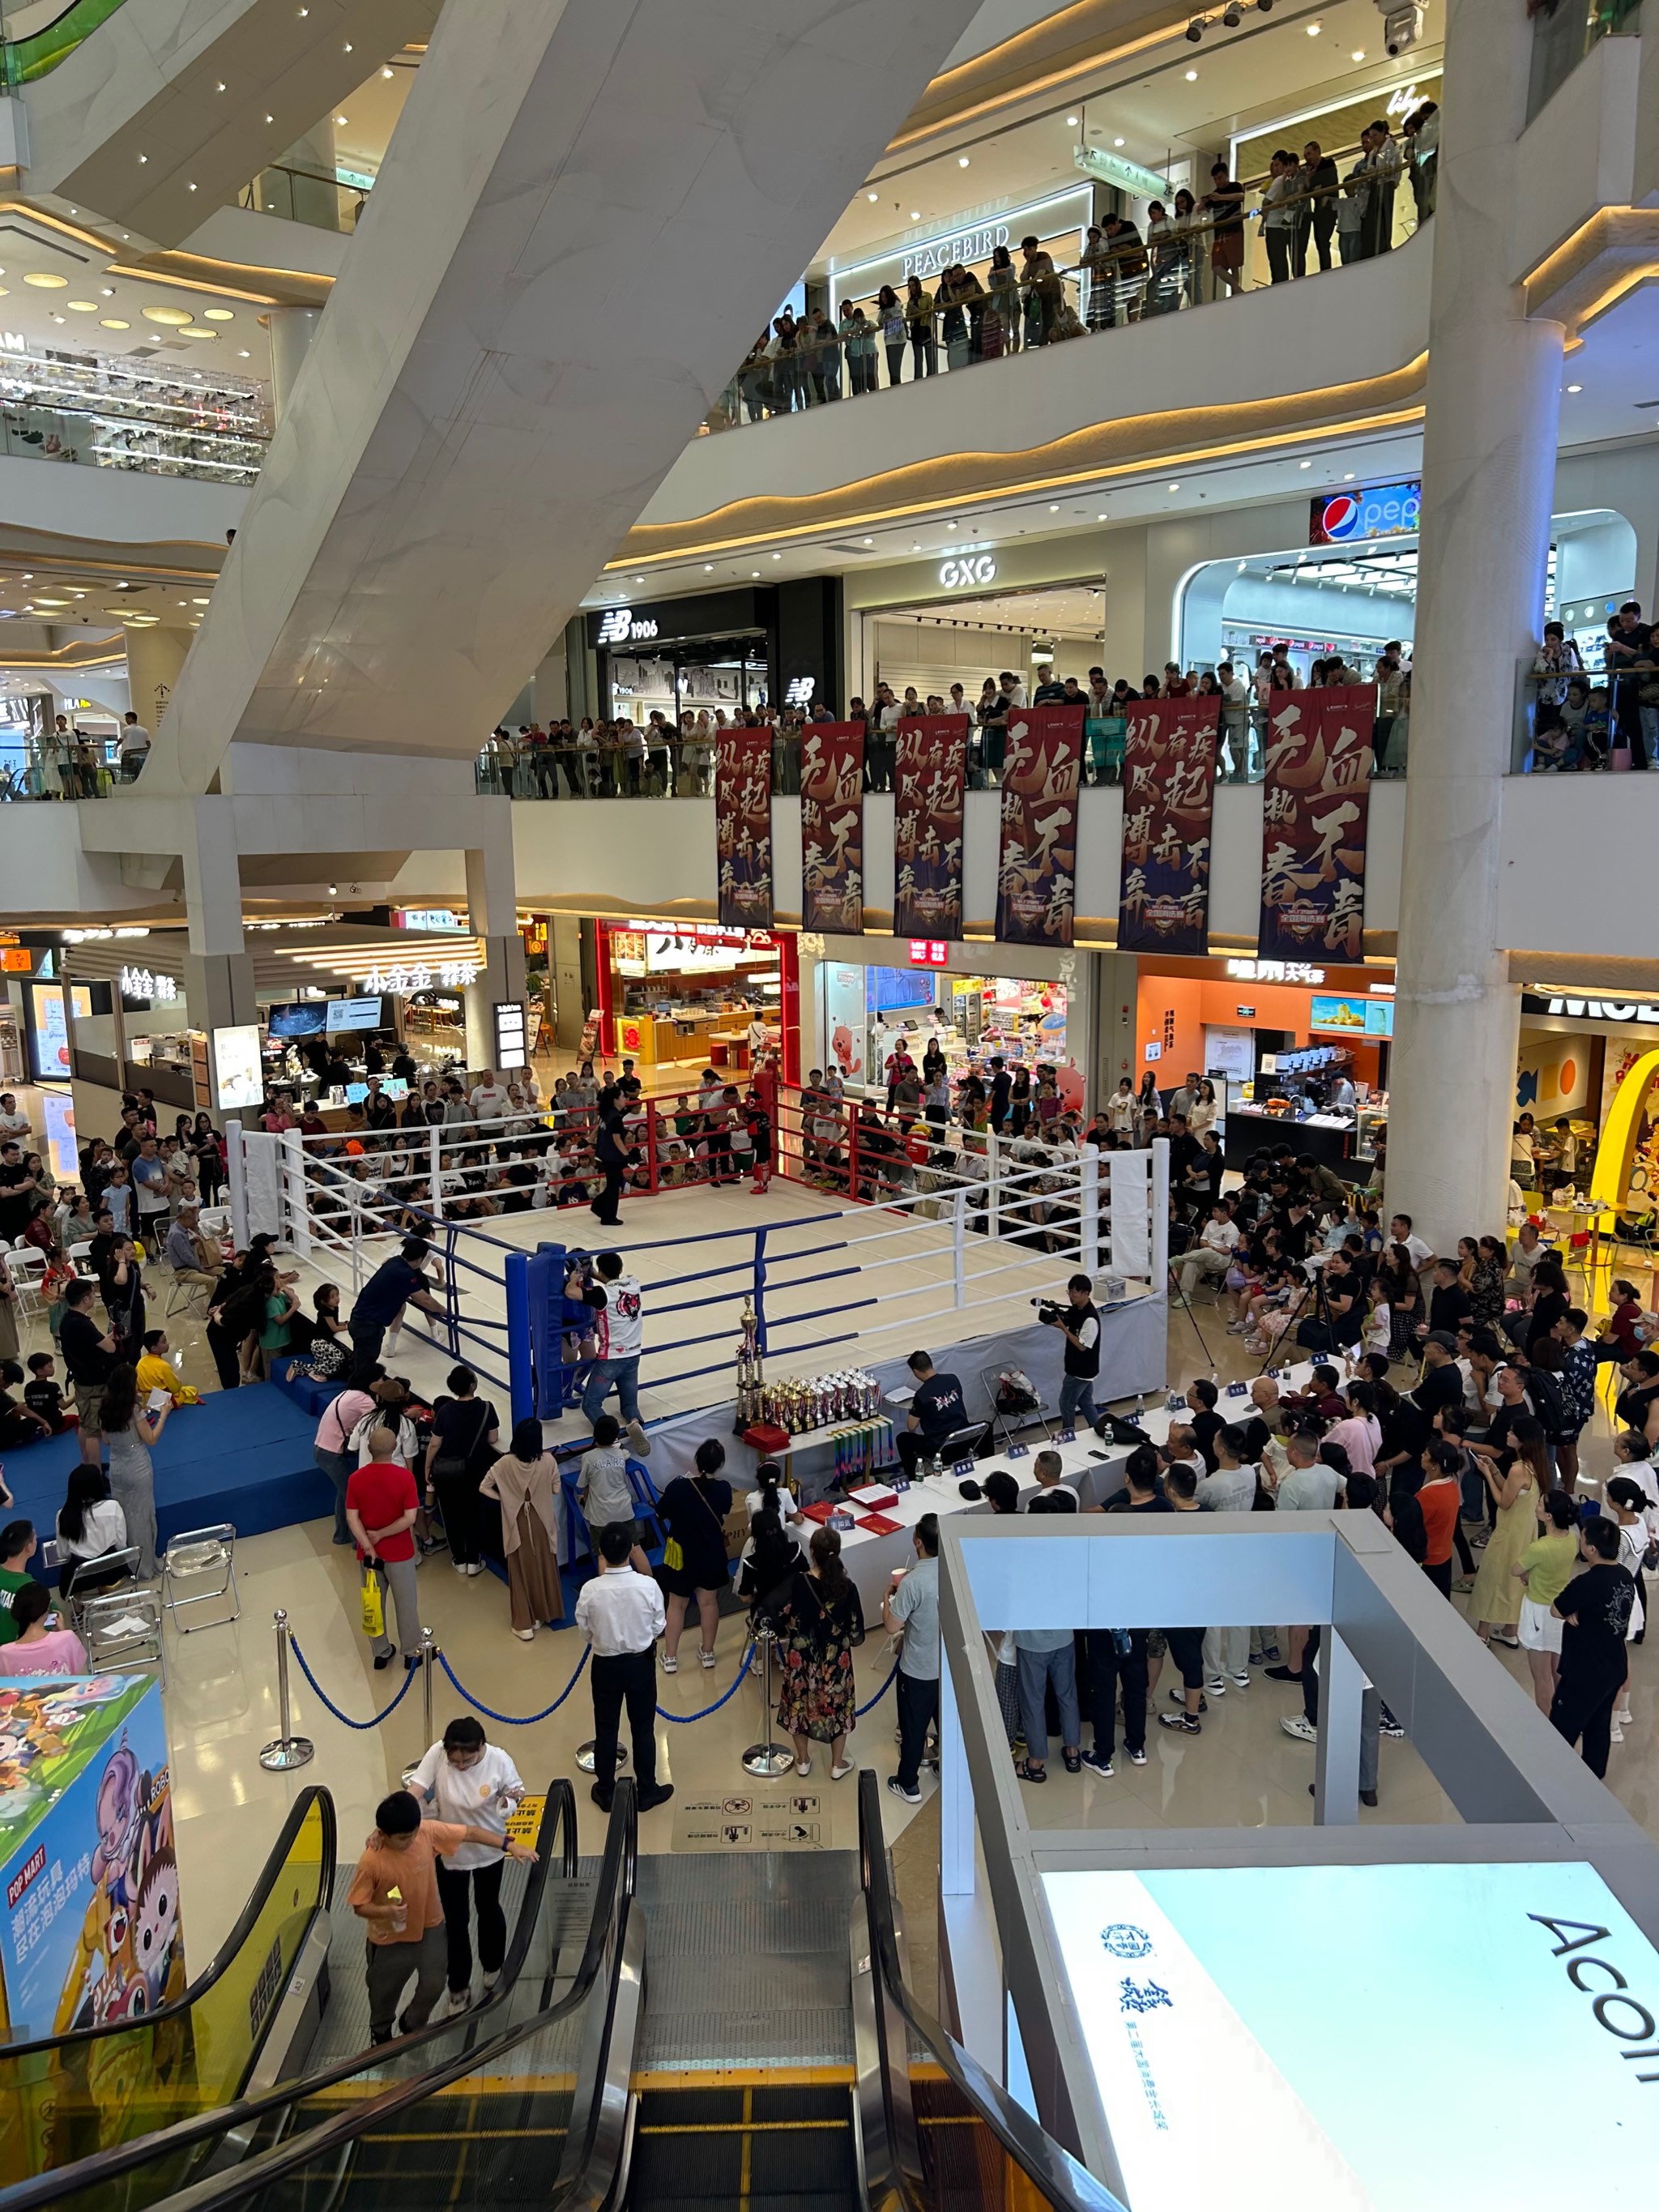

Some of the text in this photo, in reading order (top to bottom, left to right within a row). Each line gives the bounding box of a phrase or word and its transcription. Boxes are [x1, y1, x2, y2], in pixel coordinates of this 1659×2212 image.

[902, 225, 1009, 280] PEACEBIRD
[940, 556, 997, 588] GXG
[631, 620, 659, 639] 1906
[9, 1848, 45, 1903] POP MART
[11, 1859, 63, 1942] 潮流玩具
[15, 1852, 91, 1965] 尽在泡泡玛特
